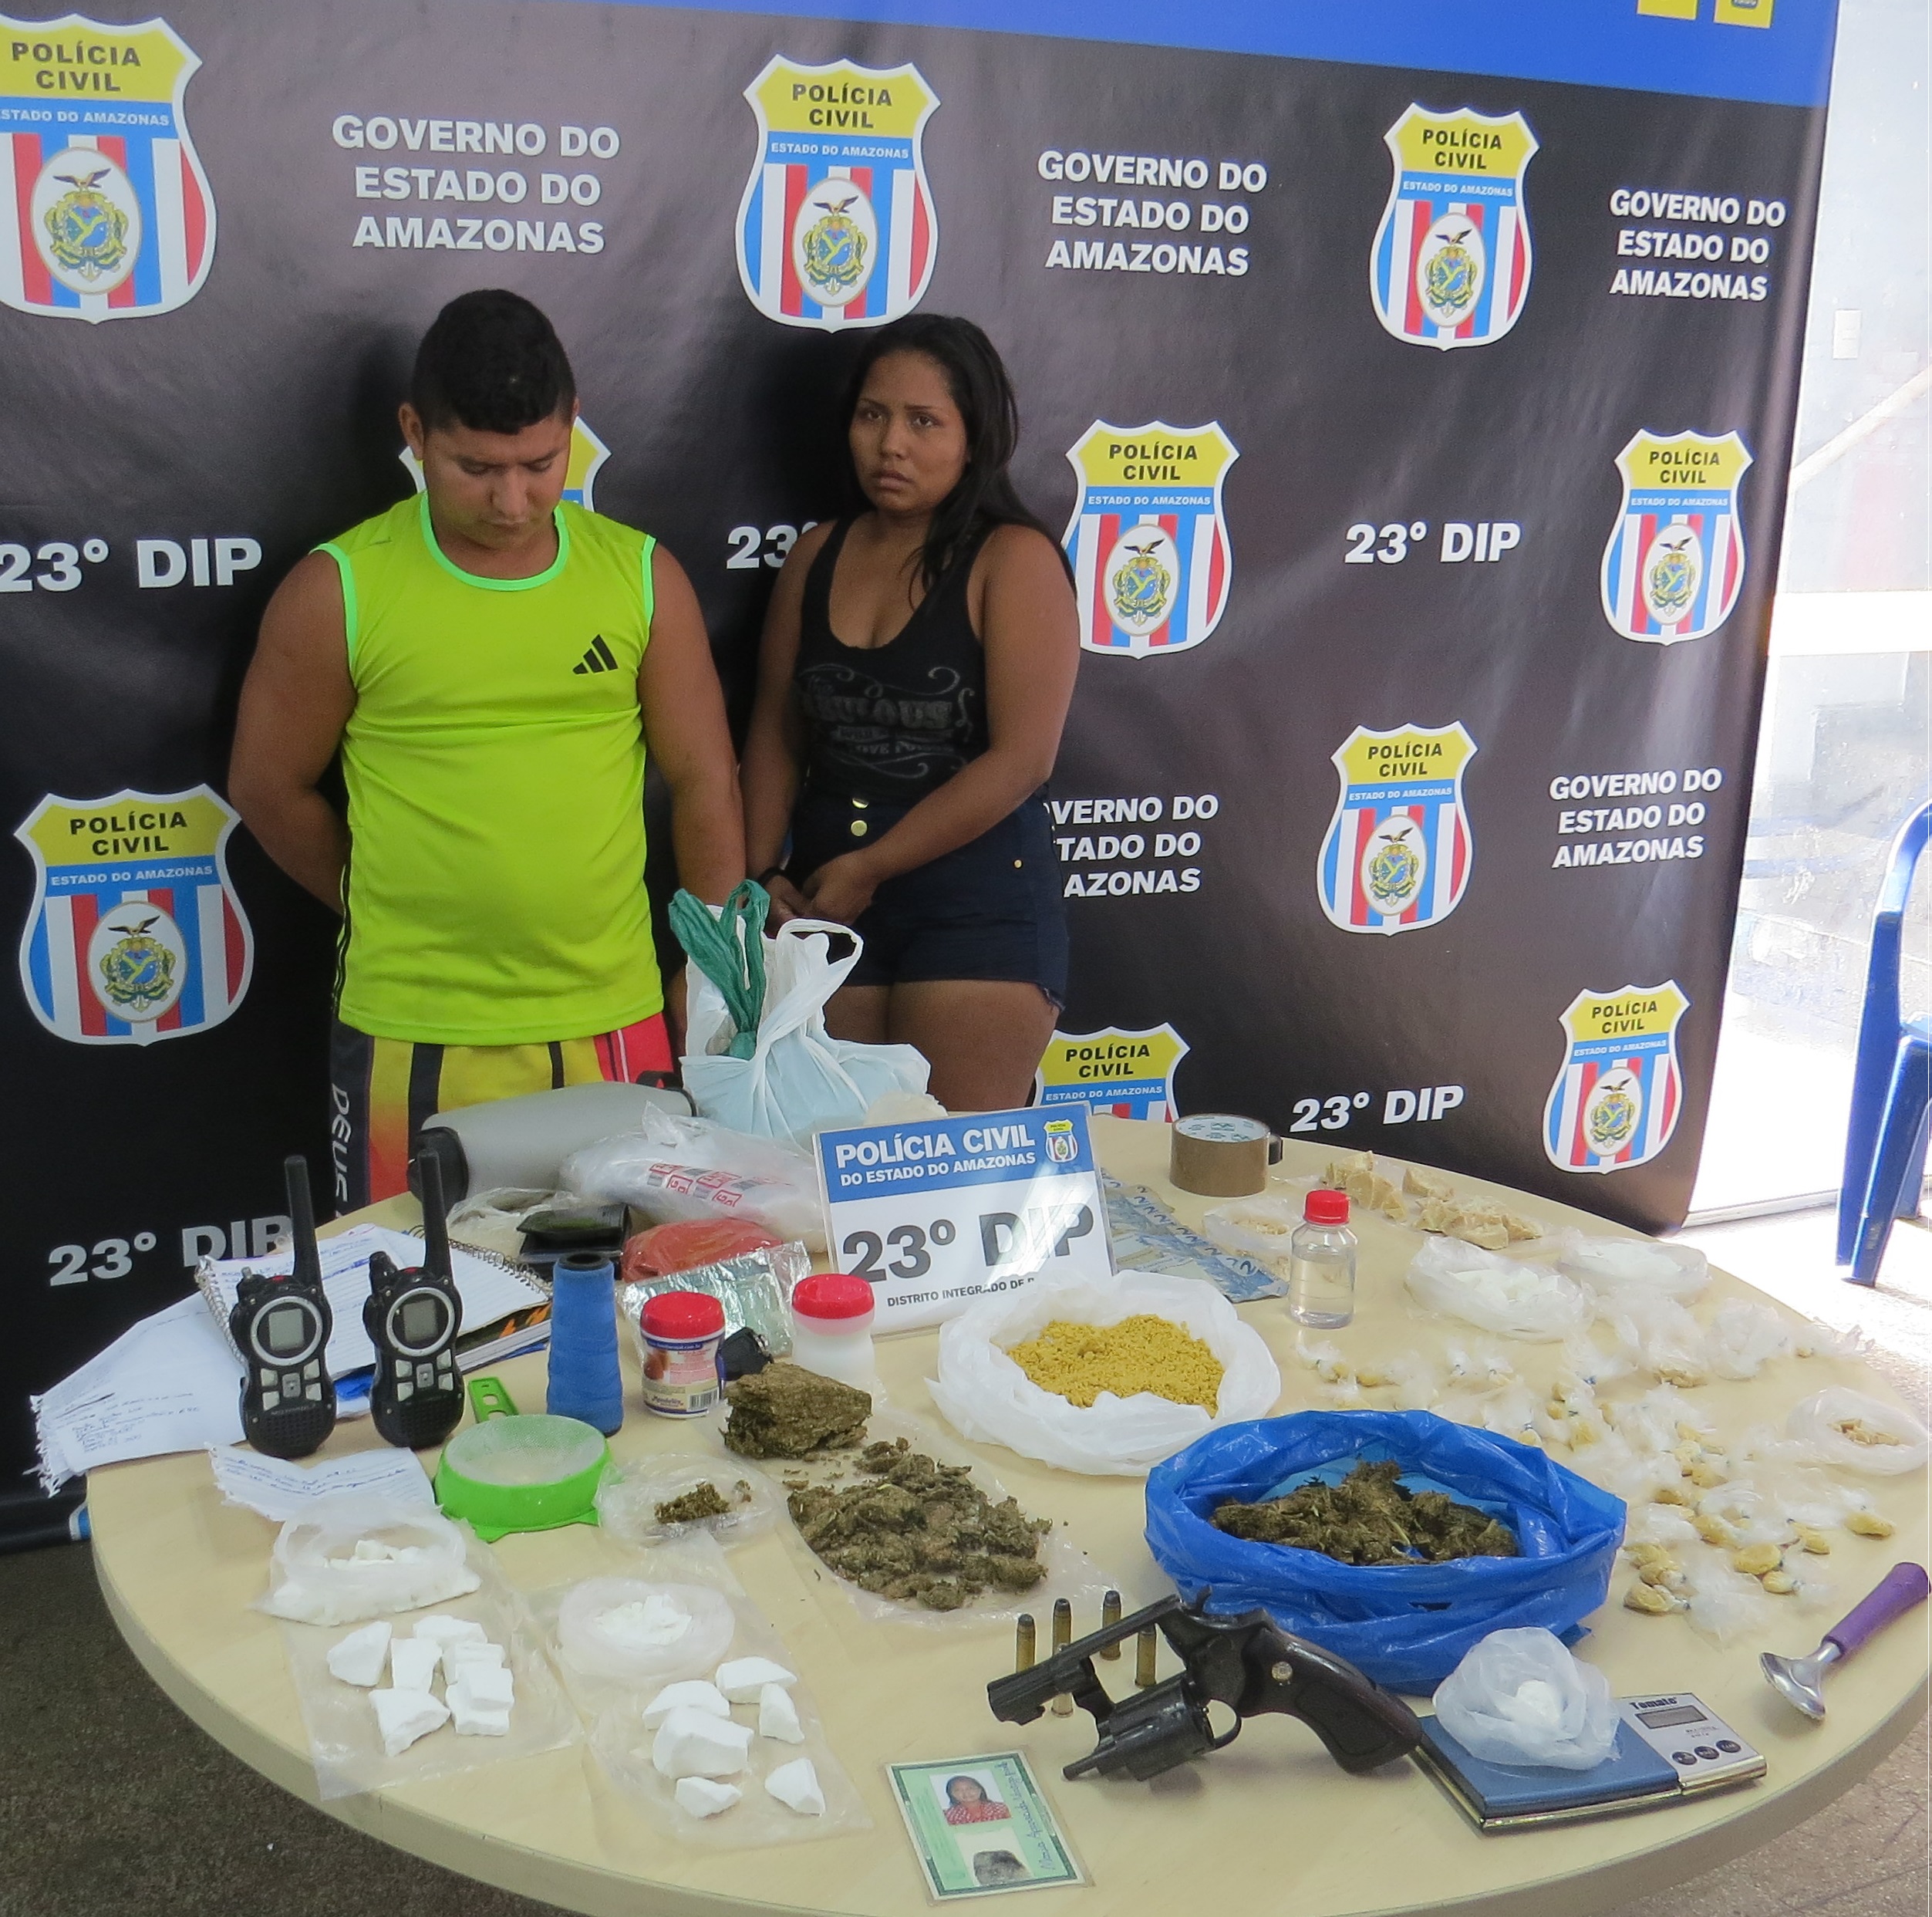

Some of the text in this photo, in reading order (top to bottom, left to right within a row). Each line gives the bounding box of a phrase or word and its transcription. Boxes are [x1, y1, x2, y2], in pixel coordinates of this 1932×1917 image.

[12, 41, 140, 66] POLÍCIA
[35, 70, 120, 92] CIVIL
[793, 83, 892, 106] POLÍCIA
[0, 109, 170, 126] STADO DO AMAZONAS
[809, 109, 873, 128] CIVIL
[332, 115, 619, 158] GOVERNO DO
[1423, 128, 1502, 150] POLÍCIA
[771, 143, 909, 158] ESTADO DO AMAZONAS
[1435, 151, 1486, 169] CIVIL
[1038, 150, 1266, 192] GOVERNO DO
[356, 167, 600, 205] ESTADO DO
[1403, 181, 1513, 197] ESTADO DO AMAZONAS
[1052, 196, 1249, 234] ESTADO DO
[1610, 189, 1785, 227] GOVERNO DO
[352, 216, 604, 253] AMAZONAS
[1045, 240, 1248, 275] AMAZONAS
[1617, 230, 1768, 263] ESTADO DO
[1610, 269, 1767, 301] AMAZONAS
[1109, 441, 1197, 460] POLÍCIA
[1650, 448, 1719, 465] POLÍCIA
[1123, 465, 1181, 480] CIVIL
[1660, 470, 1706, 484] CIVIL
[1088, 496, 1211, 505] ESTADO DO AMAZONAS
[1441, 523, 1520, 562] DIP
[137, 538, 261, 588] DIP
[1368, 741, 1442, 760] POLÍCIA
[1379, 762, 1428, 777] CIVIL
[1349, 791, 1385, 801] ESTADO
[1402, 787, 1452, 798] AMAZONAS
[1550, 768, 1721, 800] GOVERNO DO
[1043, 795, 1218, 824] VERNO DO
[1559, 802, 1704, 833] ESTADO DO
[70, 811, 187, 835] POLÍCIA
[93, 835, 169, 856] CIVIL
[1053, 832, 1201, 861] TADO DO
[1552, 835, 1704, 868] AMAZONAS
[51, 866, 212, 886] ESTADO DO AMAZONAS
[1064, 868, 1201, 897] AZONAS
[1592, 1001, 1657, 1018] POLÍCIA
[1602, 1018, 1644, 1034] CIVIL
[1066, 1043, 1150, 1061] POLÍCIA
[1079, 1062, 1134, 1078] CIVIL
[1046, 1086, 1163, 1102] ESTADO DO AMAZONAS
[1383, 1085, 1464, 1124] DIP
[836, 1125, 1035, 1169] POLÍCIA CIVIL
[841, 1153, 1035, 1186] DO ESTADO DO AMAZONAS
[182, 1216, 293, 1267] DIP
[887, 1291, 939, 1307] DISTRITO
